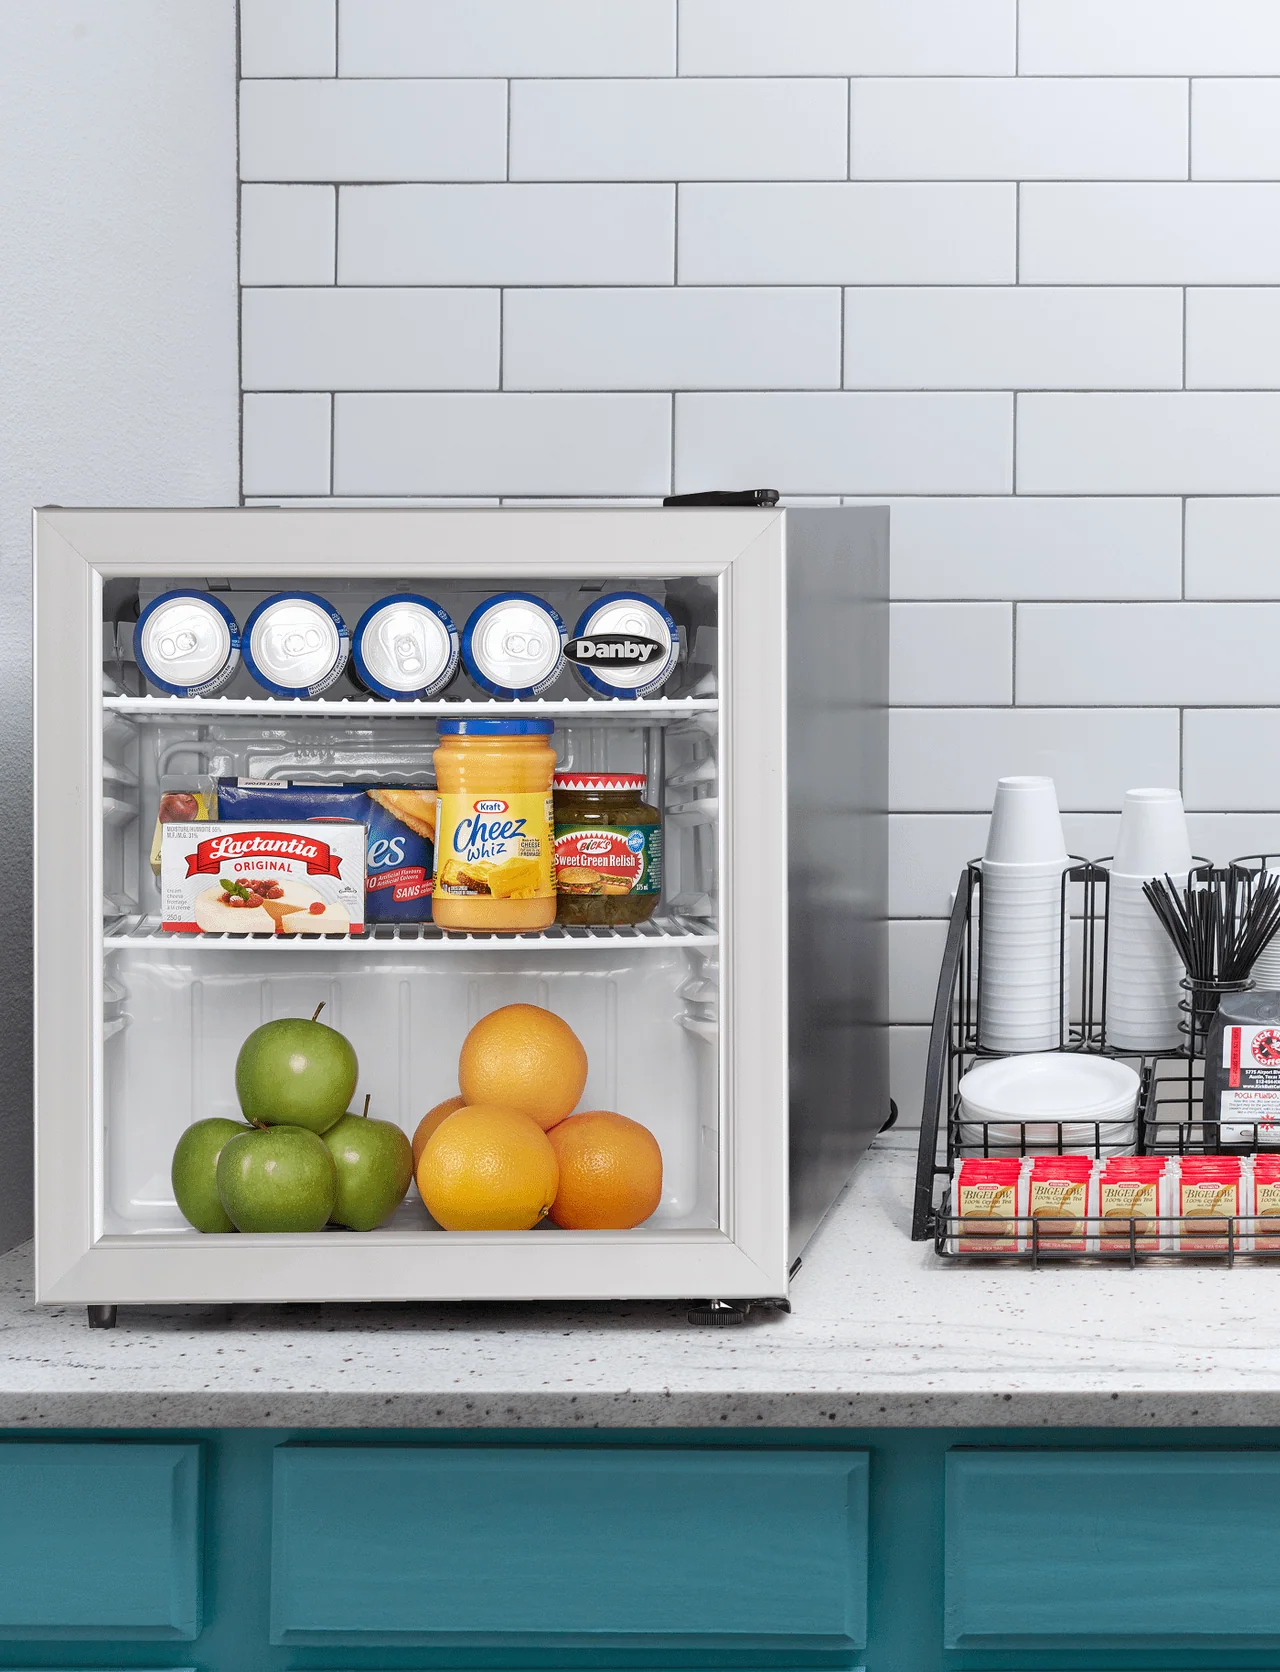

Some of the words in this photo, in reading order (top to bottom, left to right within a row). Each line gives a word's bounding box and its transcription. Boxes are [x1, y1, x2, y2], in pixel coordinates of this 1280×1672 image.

[577, 641, 654, 662] Danby
[555, 654, 565, 670] Fact
[188, 679, 217, 692] Nutrition
[216, 664, 231, 680] Facts
[308, 671, 334, 691] Nutrition
[332, 654, 343, 672] Facts
[480, 803, 501, 811] Kraft
[453, 814, 527, 853] Cheez
[209, 836, 318, 860] Lactantia
[466, 843, 507, 862] whiz
[234, 860, 293, 873] ORIGINAL
[554, 853, 580, 866] Sweet
[581, 854, 608, 867] Green
[609, 854, 636, 867] Relish
[396, 885, 421, 898] SANS
[1253, 1031, 1271, 1048] Kick
